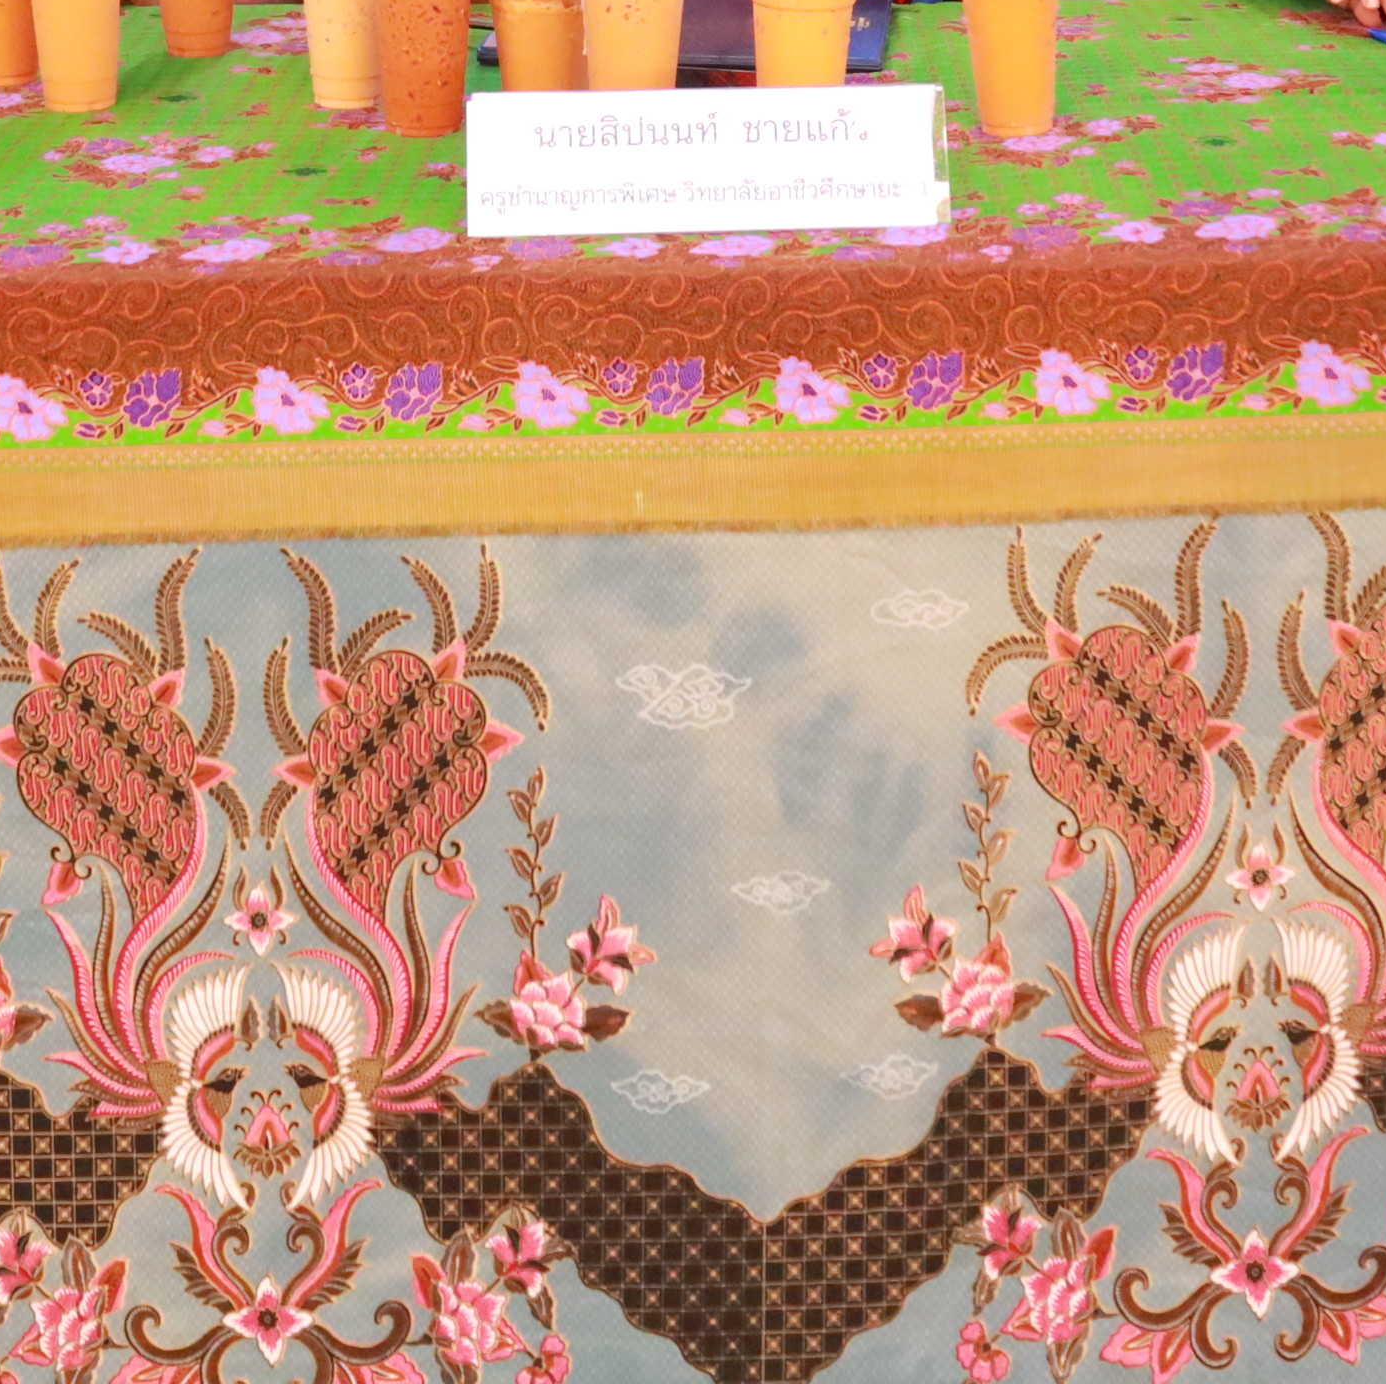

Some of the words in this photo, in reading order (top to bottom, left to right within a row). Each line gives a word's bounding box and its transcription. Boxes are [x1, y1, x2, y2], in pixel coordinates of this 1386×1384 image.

[534, 111, 718, 148] นายสิปนนท์
[481, 182, 677, 215] ครูชำนาญการพิเศษ
